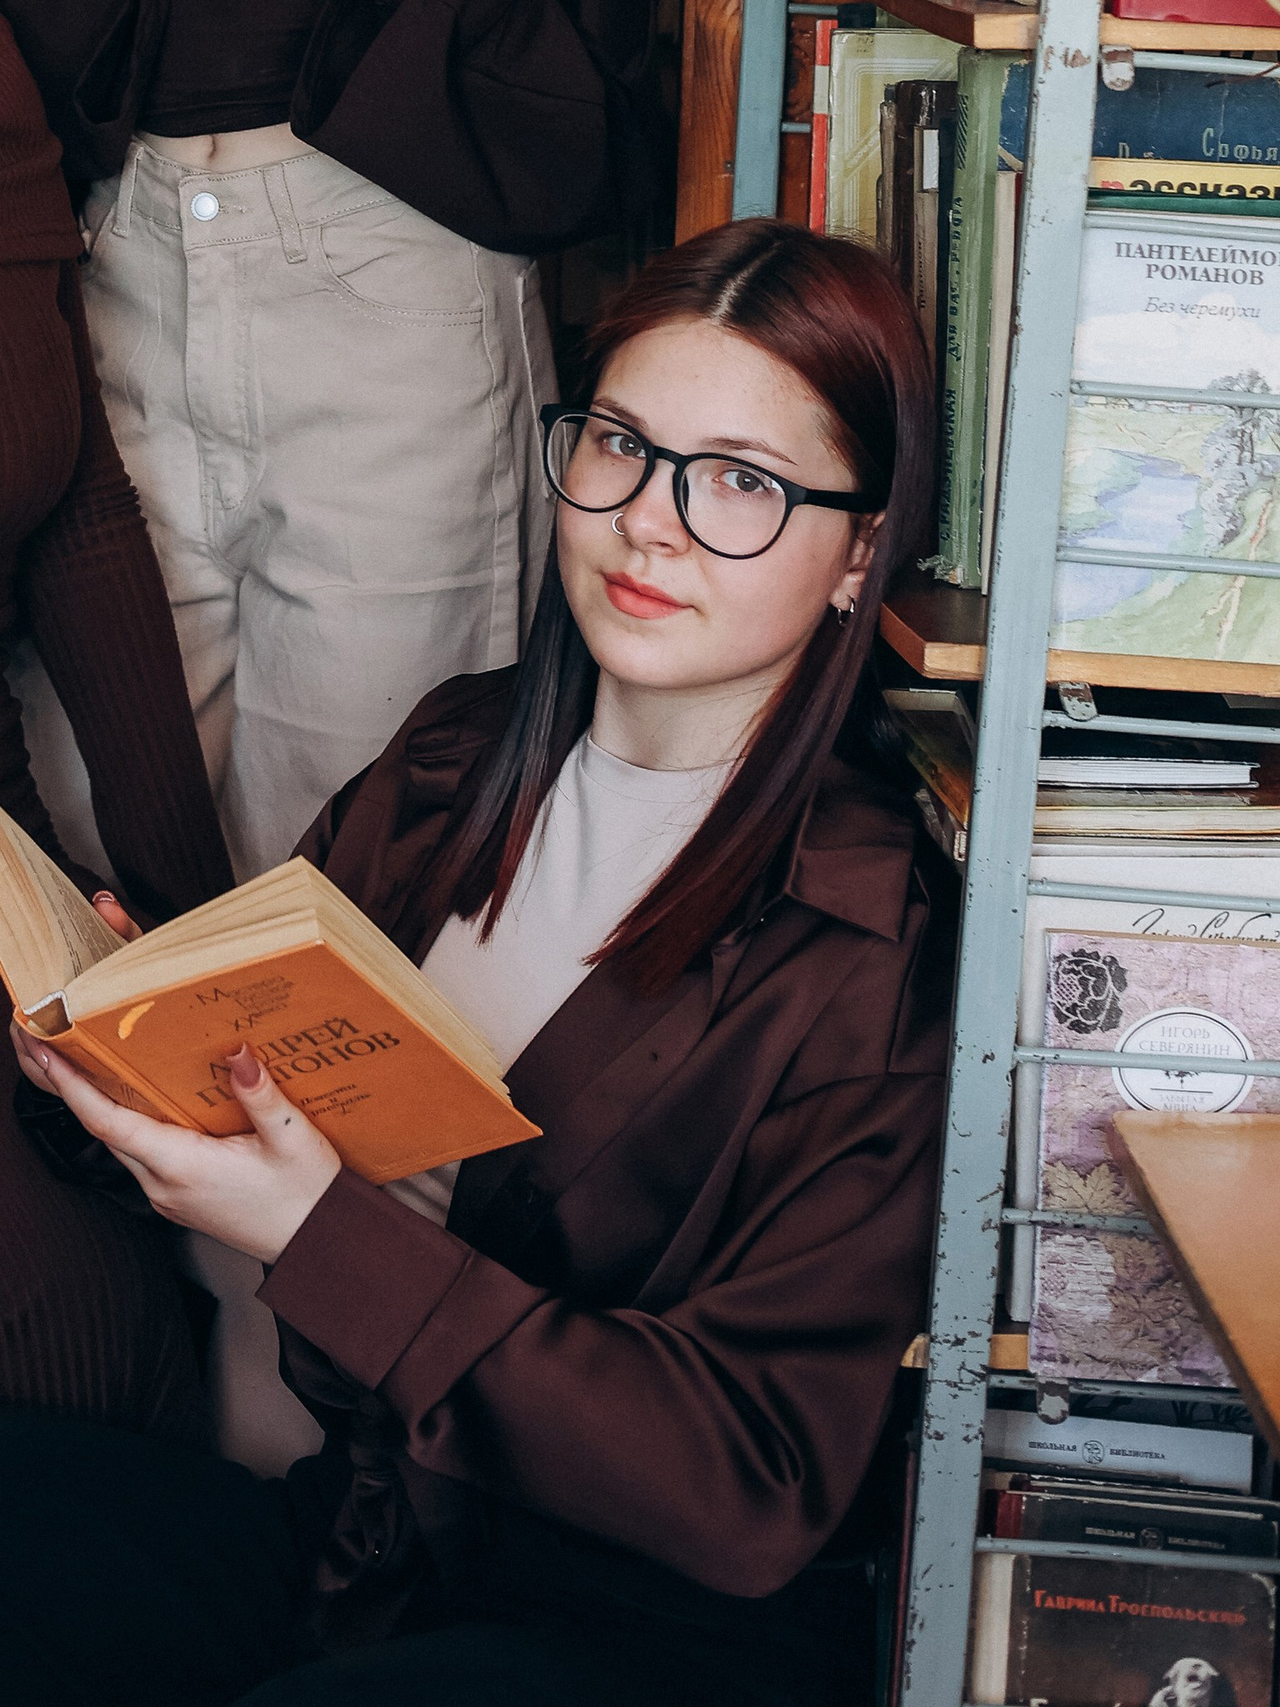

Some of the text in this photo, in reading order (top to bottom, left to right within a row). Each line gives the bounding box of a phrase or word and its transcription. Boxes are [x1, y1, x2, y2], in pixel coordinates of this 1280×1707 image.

[1115, 241, 1280, 267] ПАНТЕЛЕЙМО
[1145, 263, 1265, 286] РОМАНОВ
[1143, 296, 1261, 322] Без черемухи
[1161, 1026, 1211, 1041] ИГОРЬ
[209, 1016, 360, 1080] АДРЕЙ
[1139, 1039, 1231, 1057] СЕВЕРЯНИН
[196, 1030, 402, 1109] ПТОНОВ
[1028, 1441, 1167, 1461] ШКОЛЬНАЯ БИБЛИОТЕКА
